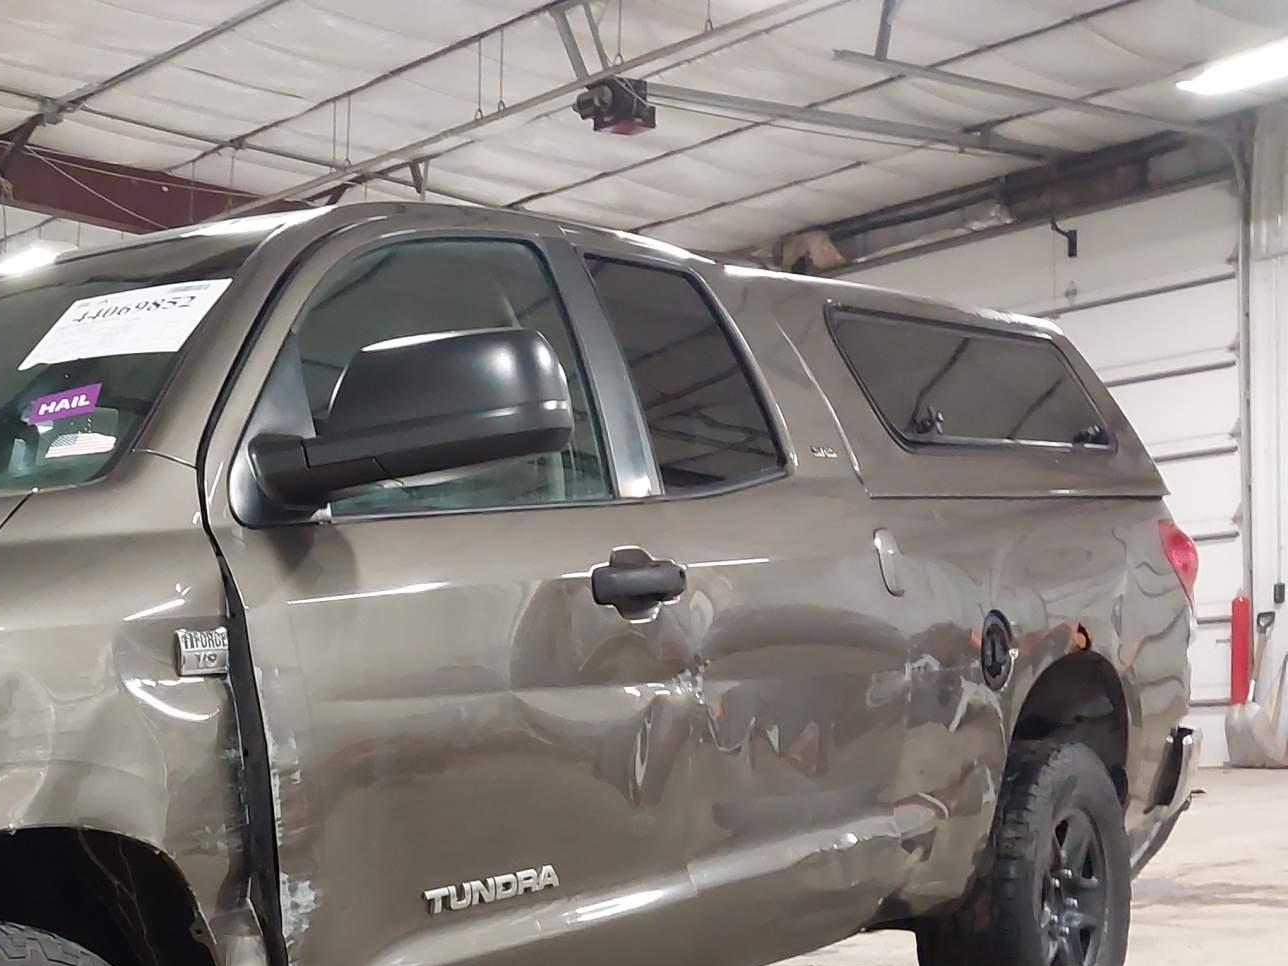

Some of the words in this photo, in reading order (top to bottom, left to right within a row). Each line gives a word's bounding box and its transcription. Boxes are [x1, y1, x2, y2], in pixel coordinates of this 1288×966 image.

[73, 294, 197, 322] 44069852
[38, 393, 91, 416] HAIL
[423, 864, 560, 914] TUNDRA
